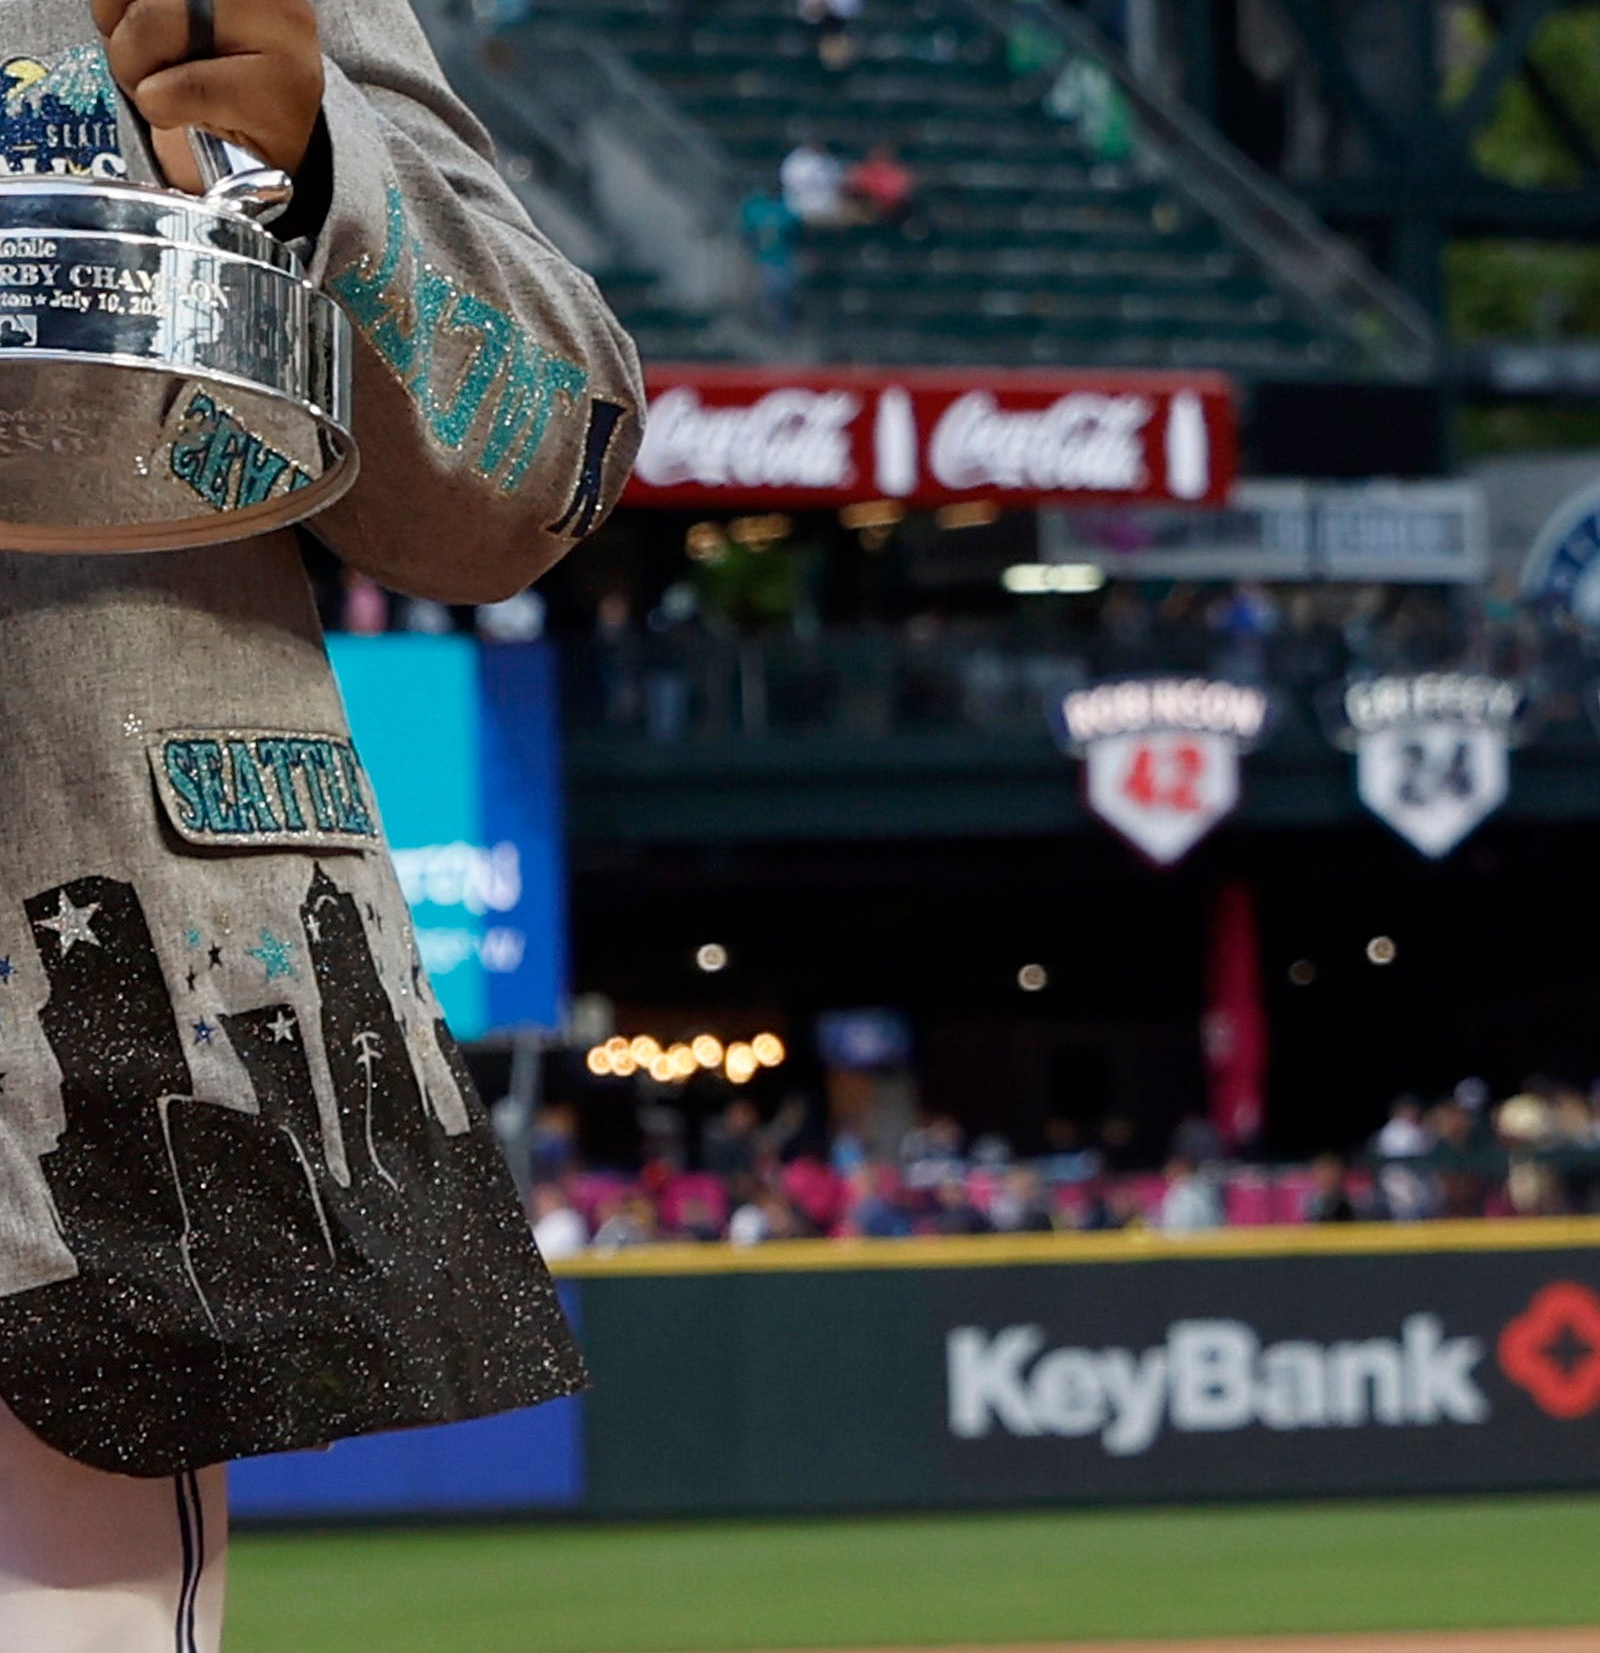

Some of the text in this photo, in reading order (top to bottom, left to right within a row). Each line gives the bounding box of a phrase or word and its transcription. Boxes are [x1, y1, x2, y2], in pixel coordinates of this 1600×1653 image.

[49, 289, 92, 314] July
[633, 386, 860, 489] Coca-Cola
[930, 391, 1150, 492] Coca-Cola
[1120, 738, 1204, 812] 42
[945, 1316, 1490, 1456] KeyBank
